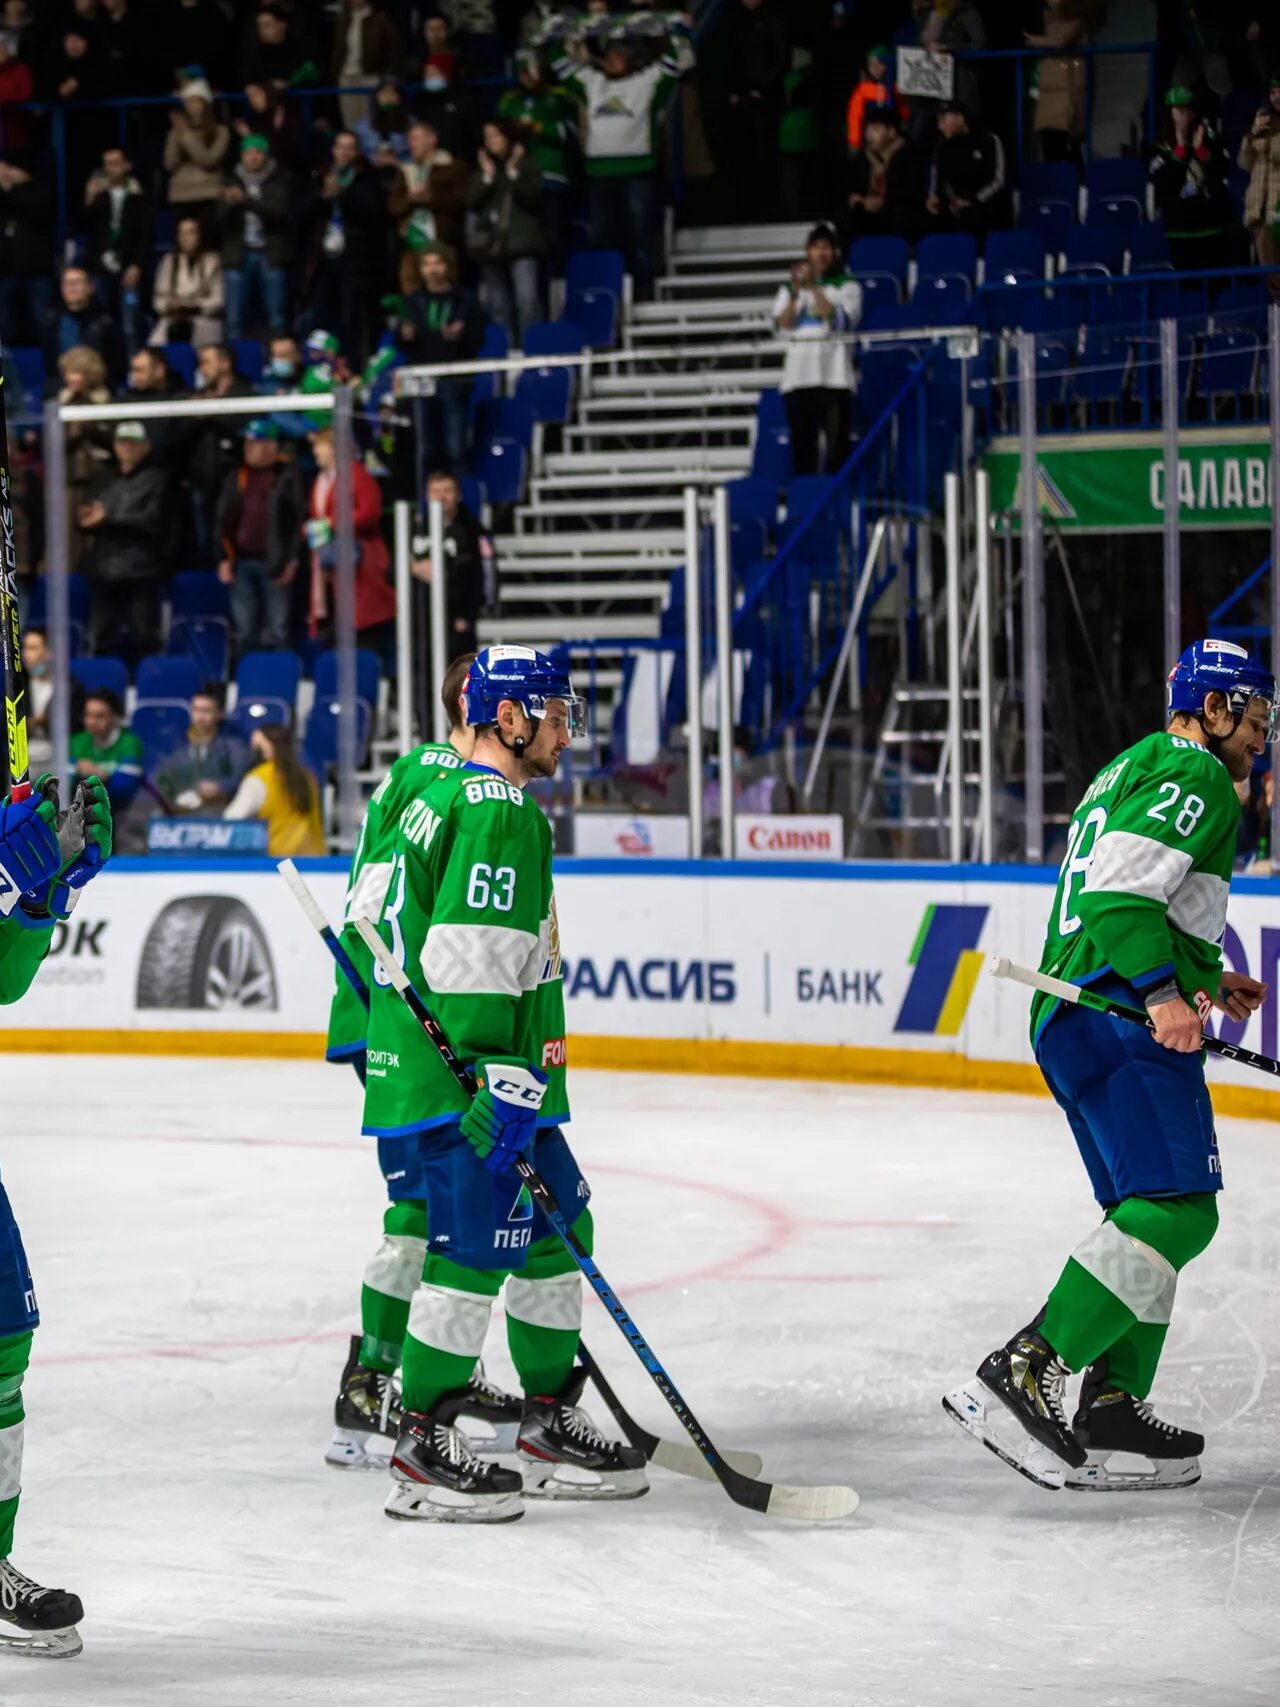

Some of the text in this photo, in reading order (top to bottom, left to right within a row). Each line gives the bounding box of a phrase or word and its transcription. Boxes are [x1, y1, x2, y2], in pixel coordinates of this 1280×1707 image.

[1149, 457, 1271, 510] САЛАВ
[0, 502, 20, 602] TACKS
[13, 607, 23, 674] SUPER
[7, 705, 17, 766] CCM
[1146, 782, 1205, 837] 28
[748, 824, 831, 850] Canon
[466, 863, 516, 912] 63
[796, 968, 886, 1006] БАНК
[493, 1077, 543, 1105] CC
